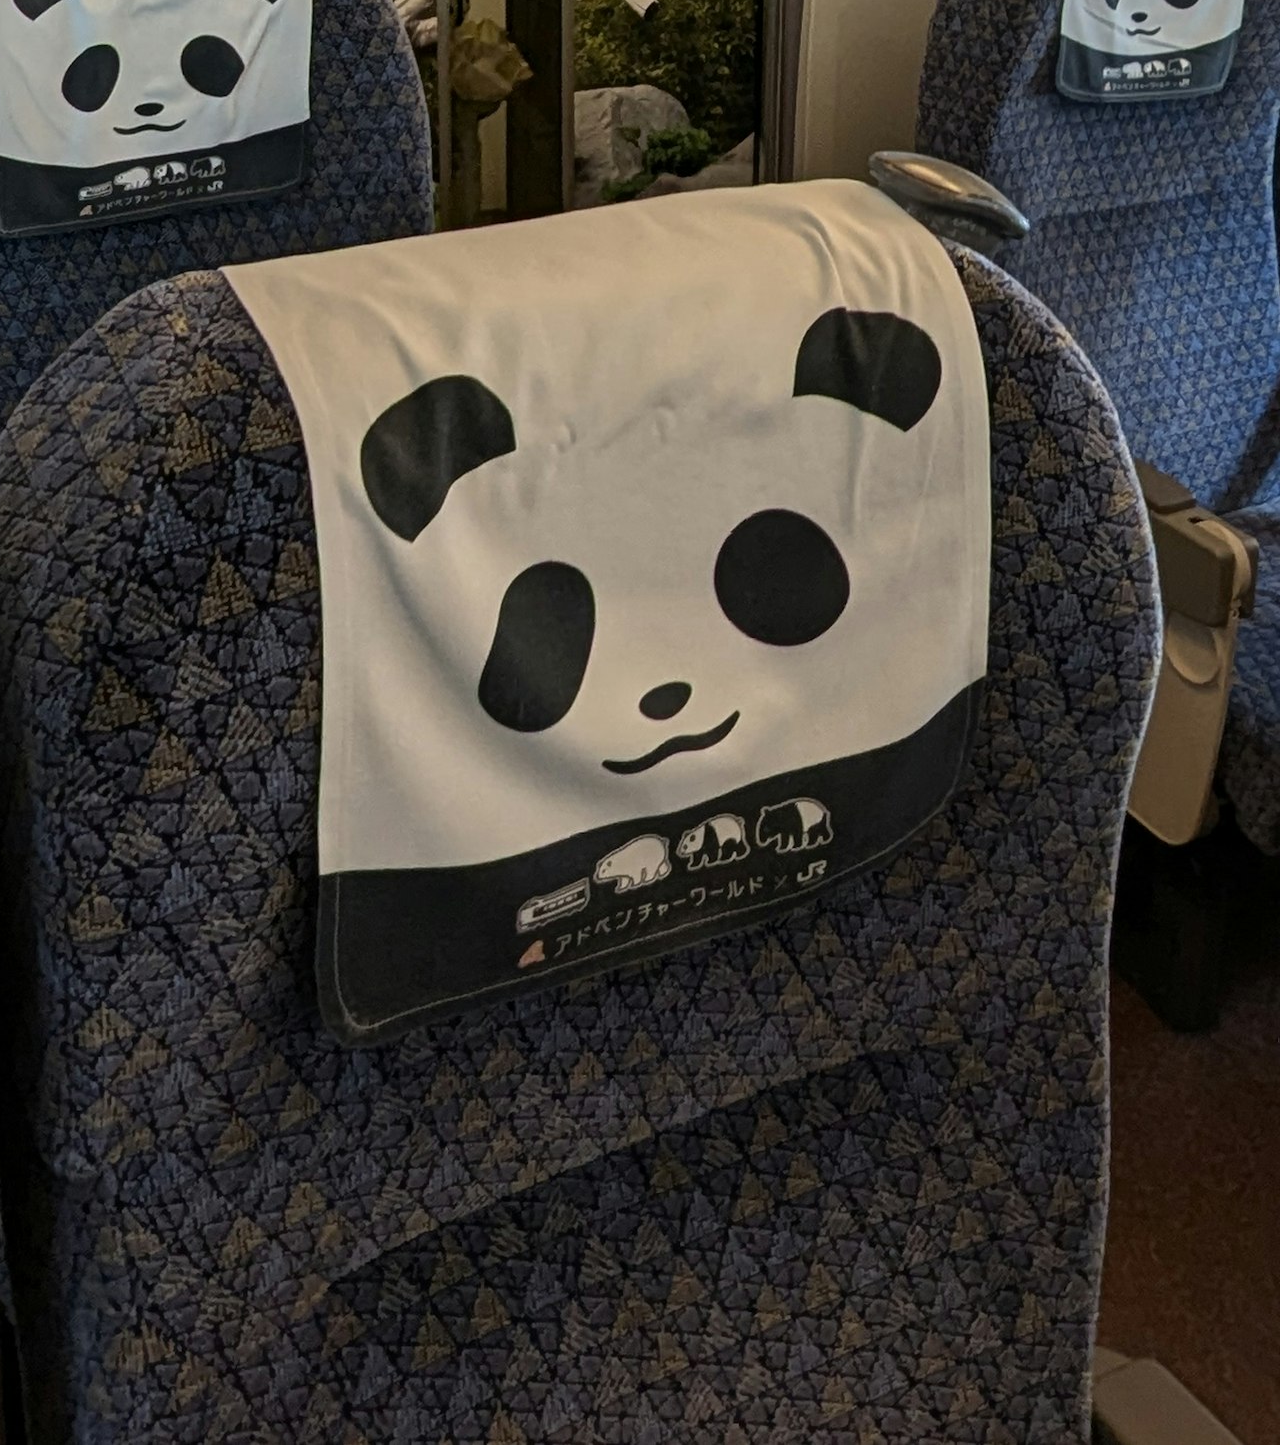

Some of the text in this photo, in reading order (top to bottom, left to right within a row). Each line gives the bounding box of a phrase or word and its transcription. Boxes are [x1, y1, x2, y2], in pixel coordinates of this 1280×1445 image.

[554, 875, 765, 957] アドベンチャーワールド
[796, 859, 828, 883] JR
